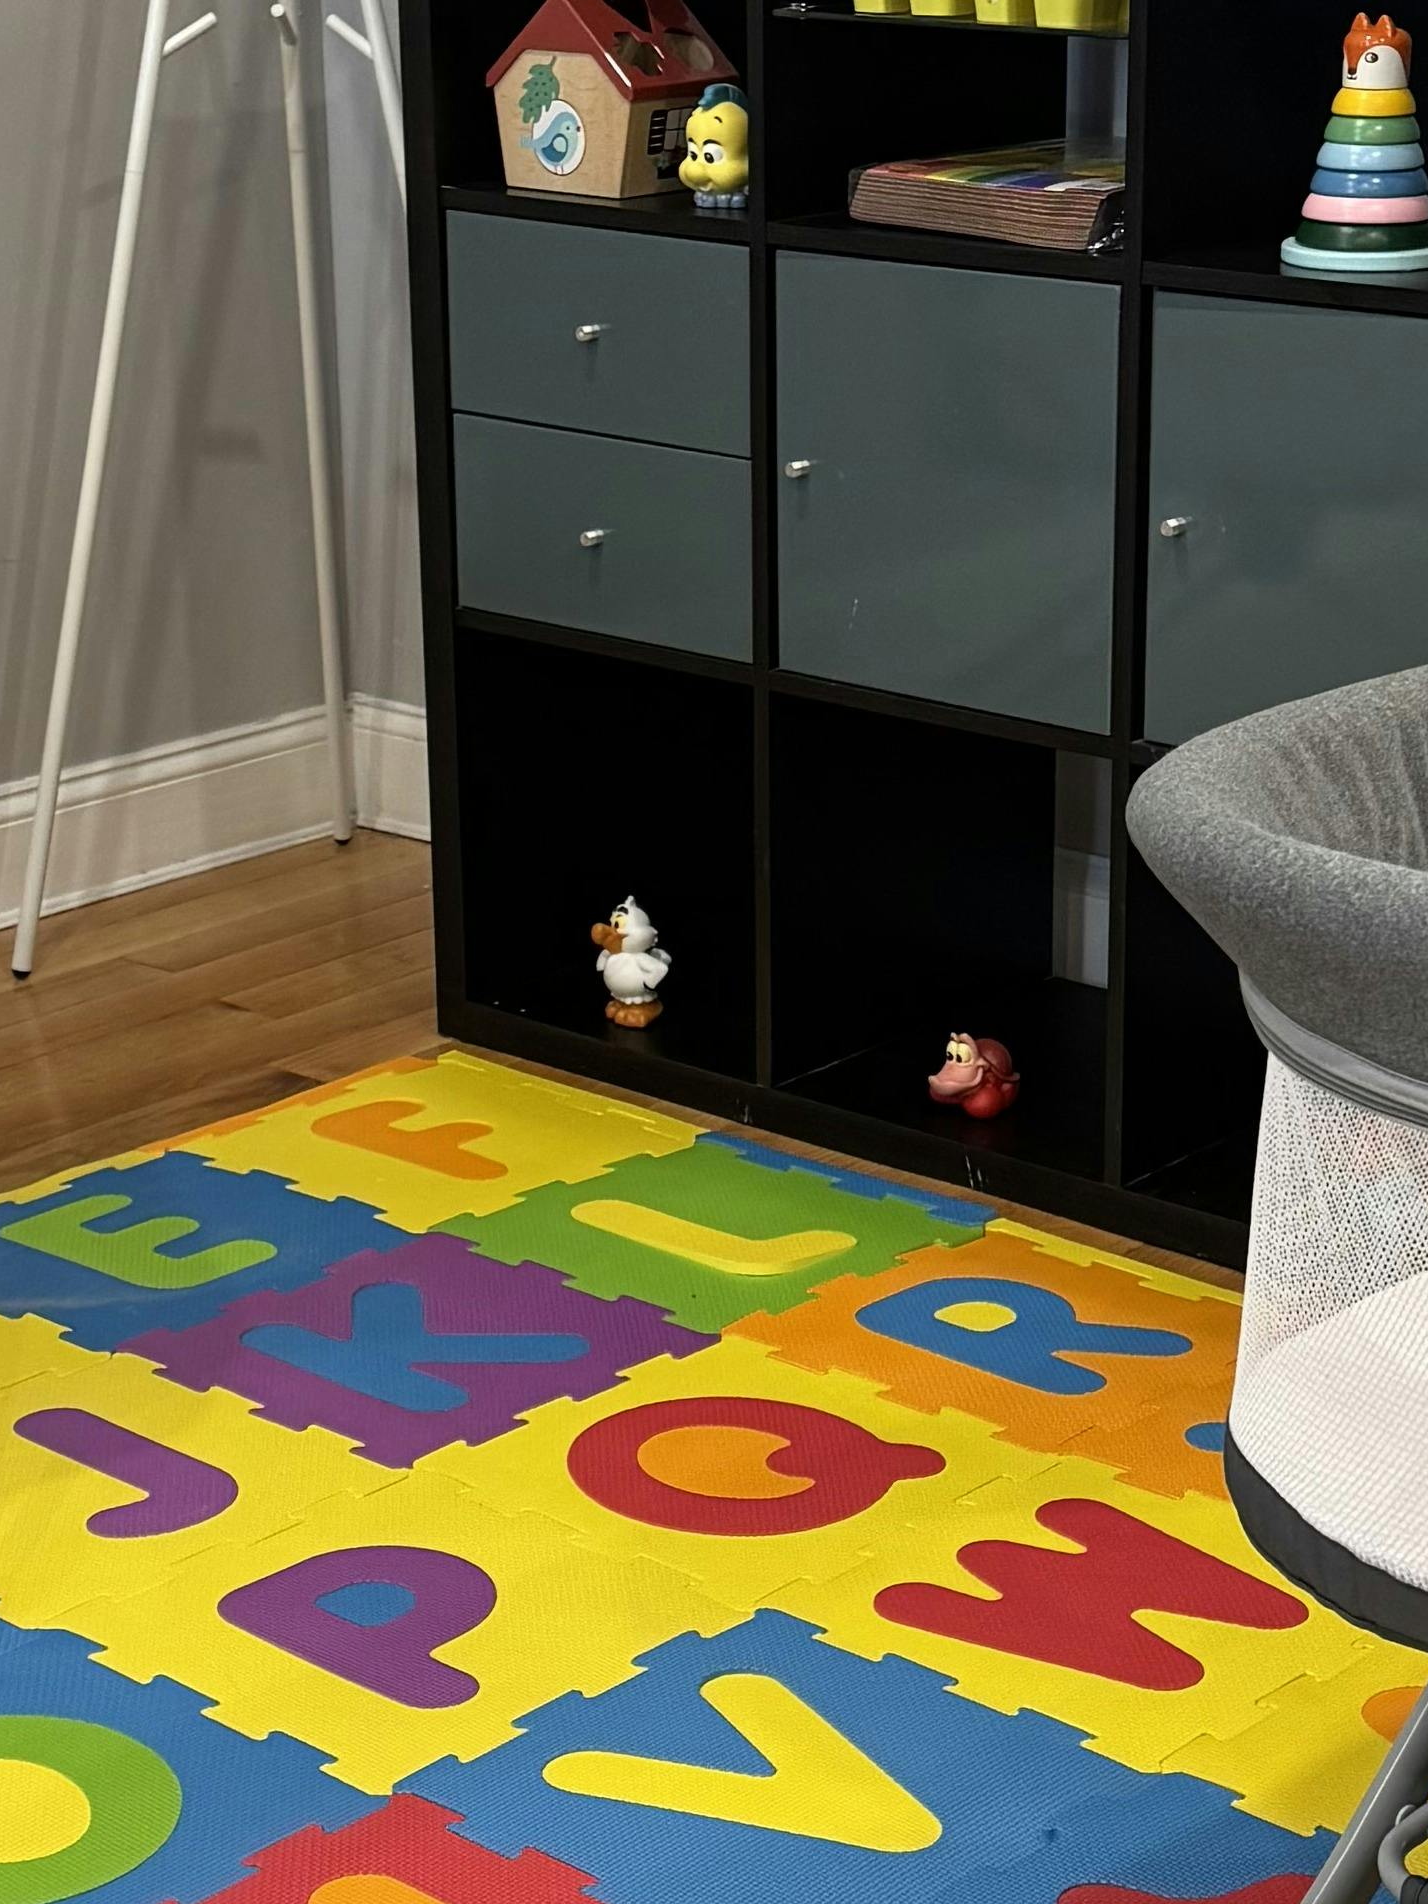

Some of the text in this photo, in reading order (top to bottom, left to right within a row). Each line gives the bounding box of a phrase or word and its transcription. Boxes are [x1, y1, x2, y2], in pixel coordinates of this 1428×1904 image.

[570, 1199, 857, 1275] L
[241, 1281, 590, 1412] K
[854, 1276, 1193, 1394] R
[12, 1407, 239, 1540] J
[567, 1395, 946, 1537] Q
[216, 1544, 497, 1710] P
